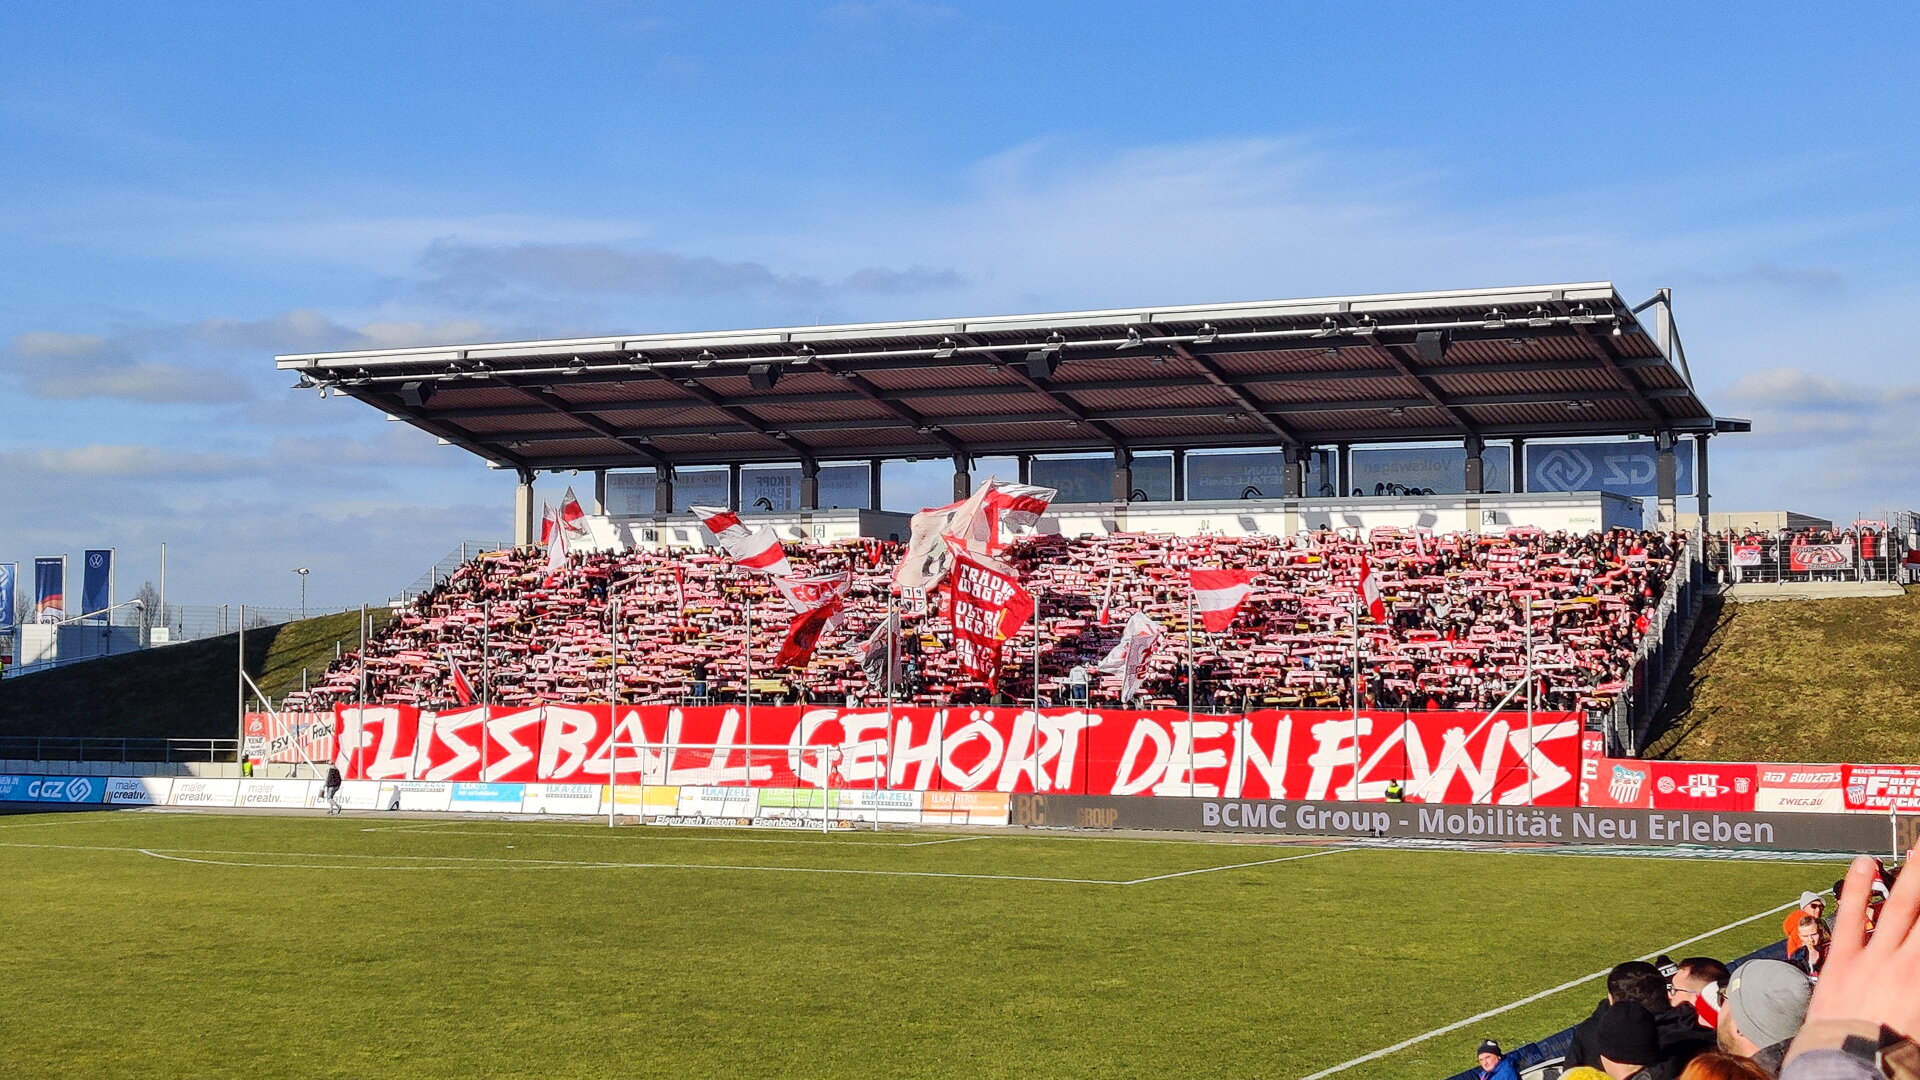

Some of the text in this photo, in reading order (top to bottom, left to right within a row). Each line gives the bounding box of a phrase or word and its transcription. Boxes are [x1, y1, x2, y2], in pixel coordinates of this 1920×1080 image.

[271, 735, 289, 751] FSV
[788, 708, 1103, 792] GEHÖRT
[1110, 714, 1292, 799] DEN
[1306, 717, 1580, 805] FANS
[1763, 772, 1842, 784] RED BOOZERS
[27, 780, 66, 798] GGZ
[115, 780, 140, 790] maler
[181, 783, 207, 792] maler
[248, 783, 274, 793] maler
[1778, 798, 1824, 806] ZWICKAU
[1203, 802, 1287, 829] BCMC
[1296, 806, 1391, 836] Group
[1418, 806, 1563, 838] Mobilität
[1572, 812, 1638, 839] Neu
[1648, 814, 1774, 844] Erleben
